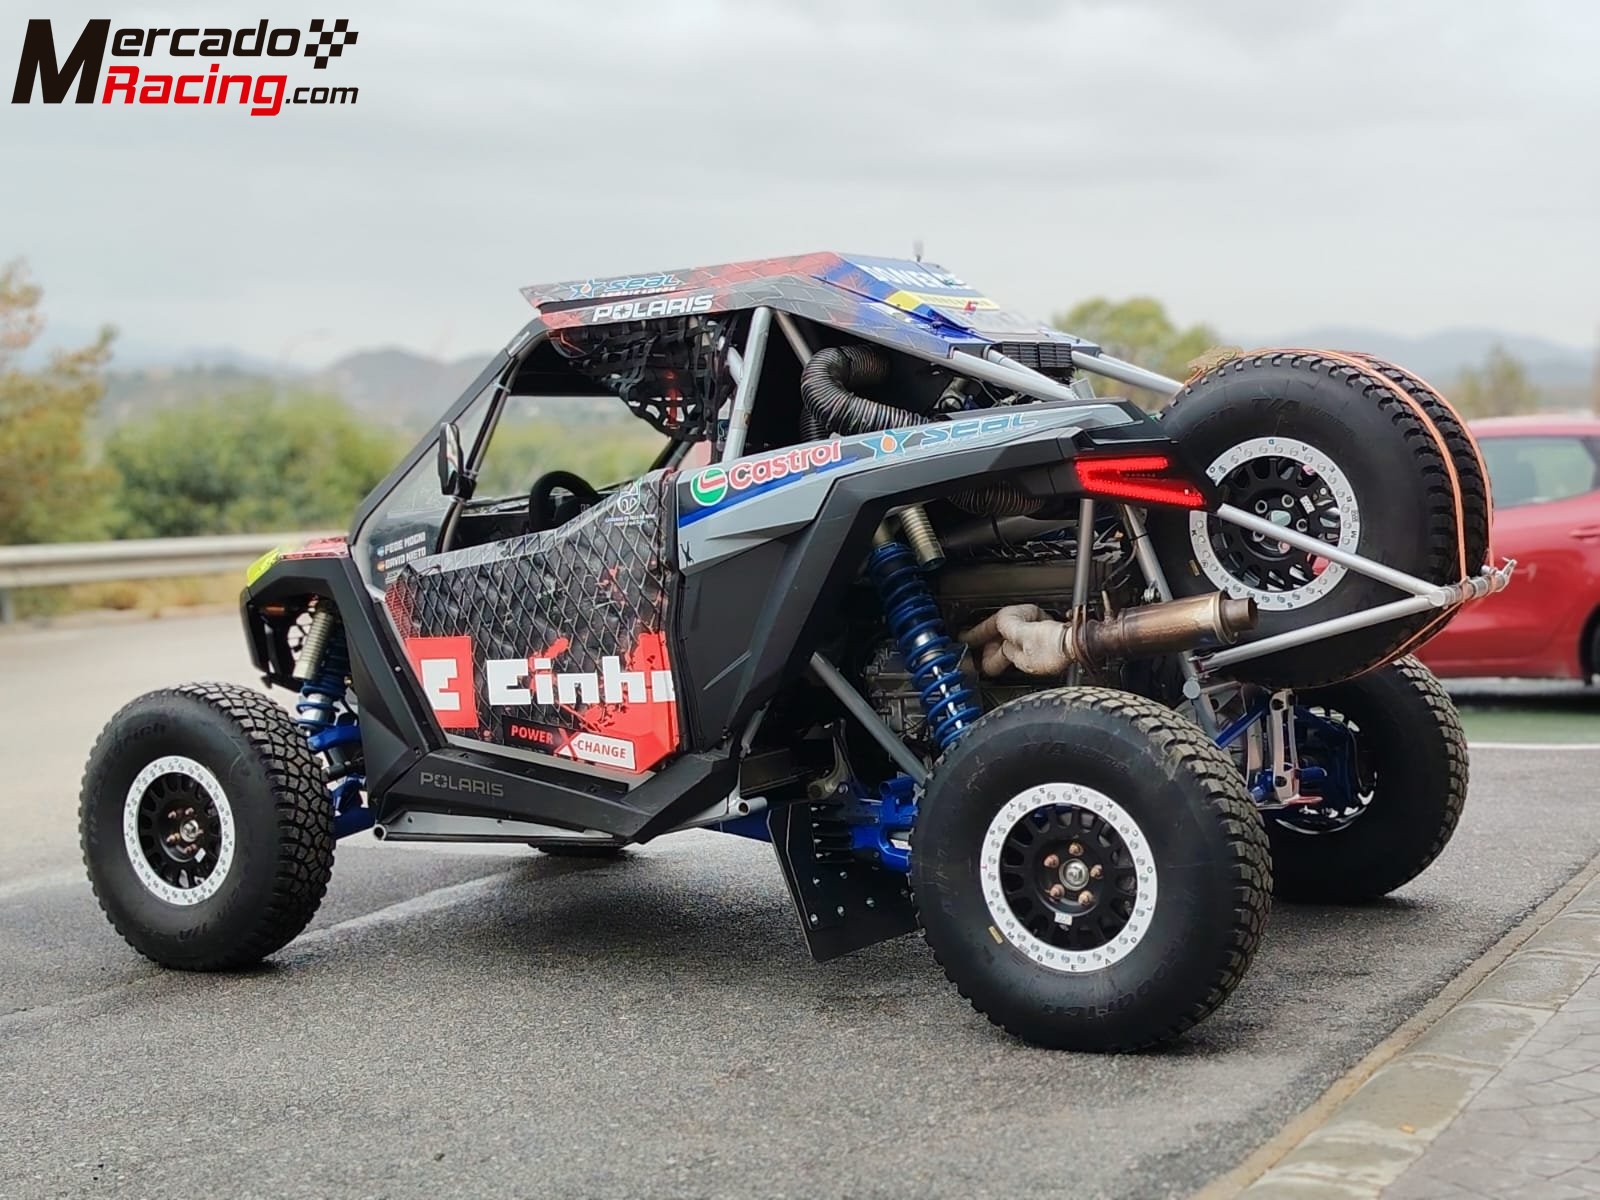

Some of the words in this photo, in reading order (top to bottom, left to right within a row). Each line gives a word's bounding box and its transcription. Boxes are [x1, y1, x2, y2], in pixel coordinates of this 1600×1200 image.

[592, 294, 713, 322] POLARIS
[729, 440, 841, 490] Castrol
[511, 725, 554, 745] POWER
[420, 771, 504, 797] POLARIS
